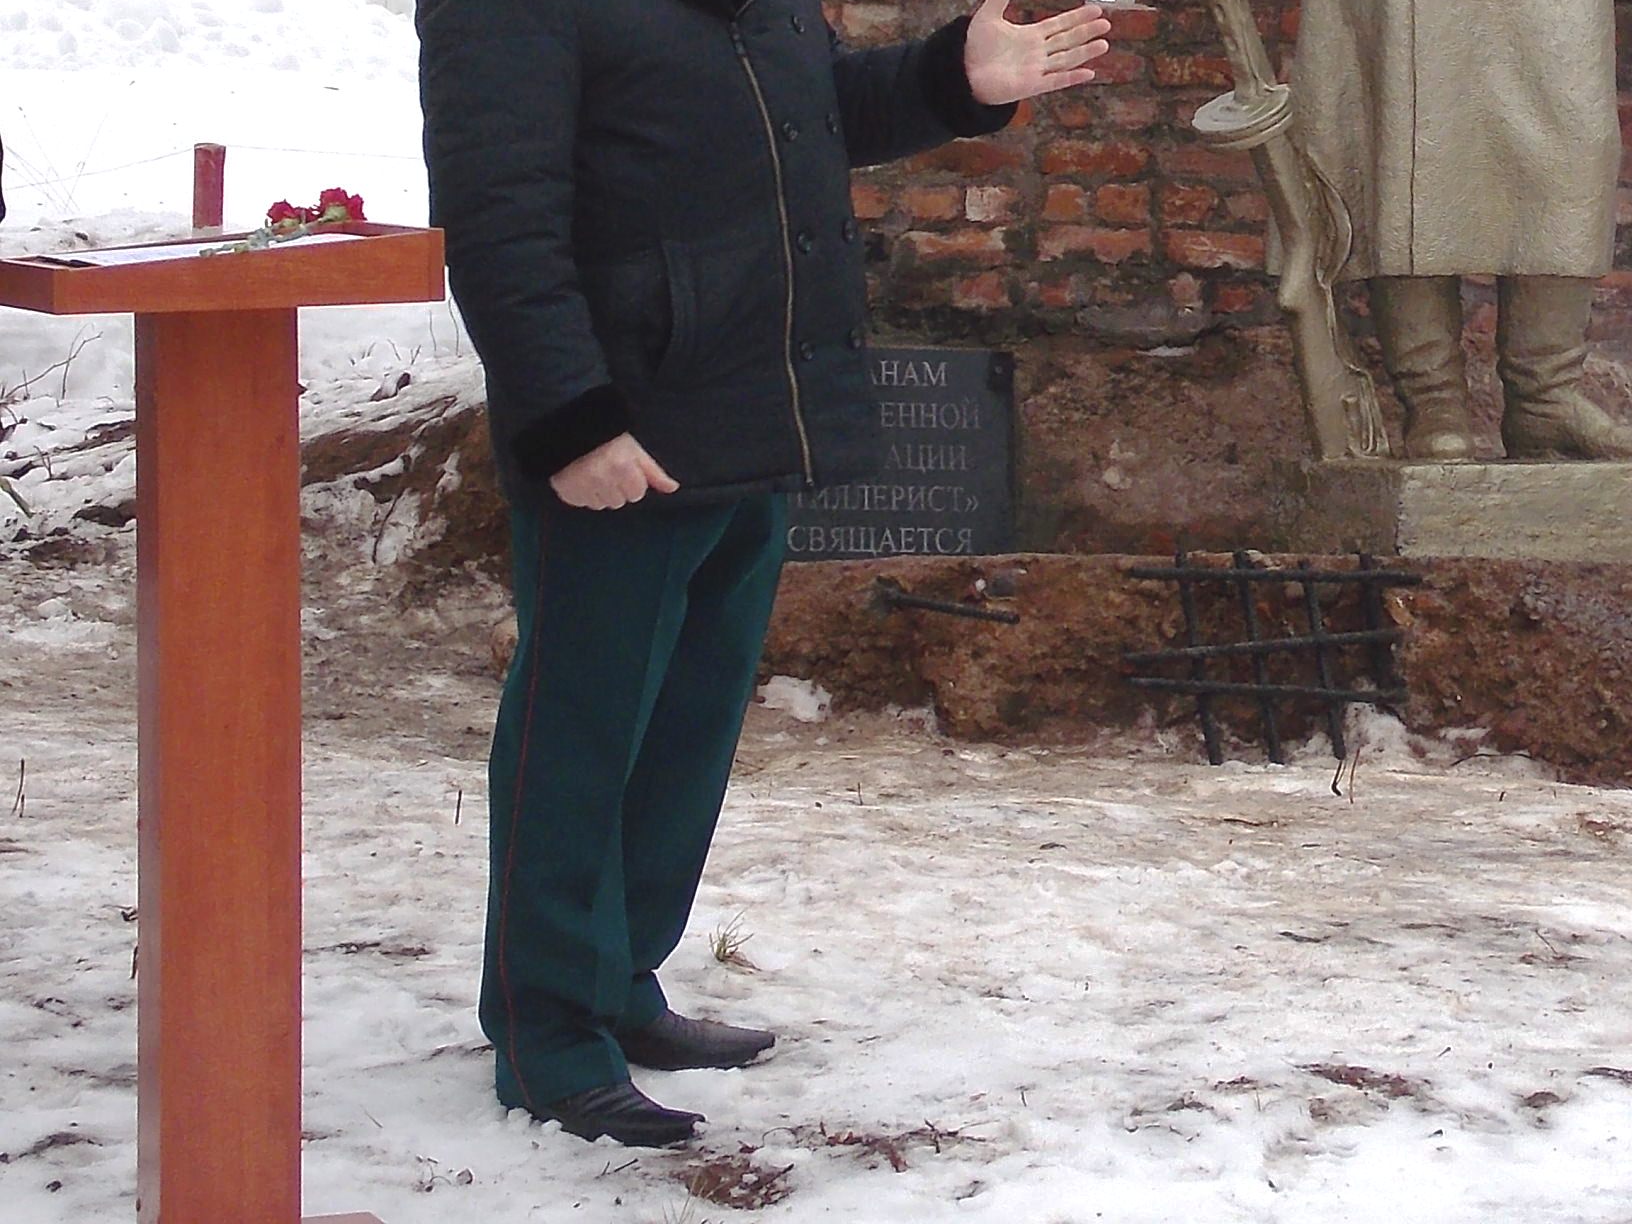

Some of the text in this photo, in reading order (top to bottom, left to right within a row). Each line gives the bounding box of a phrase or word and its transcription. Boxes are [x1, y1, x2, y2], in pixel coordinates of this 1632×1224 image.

[870, 359, 949, 387] НАМ
[880, 396, 982, 430] ЕННОЙ
[884, 442, 968, 473] АЦИИ
[787, 524, 974, 555] СВЯЩАЕТСЯ
